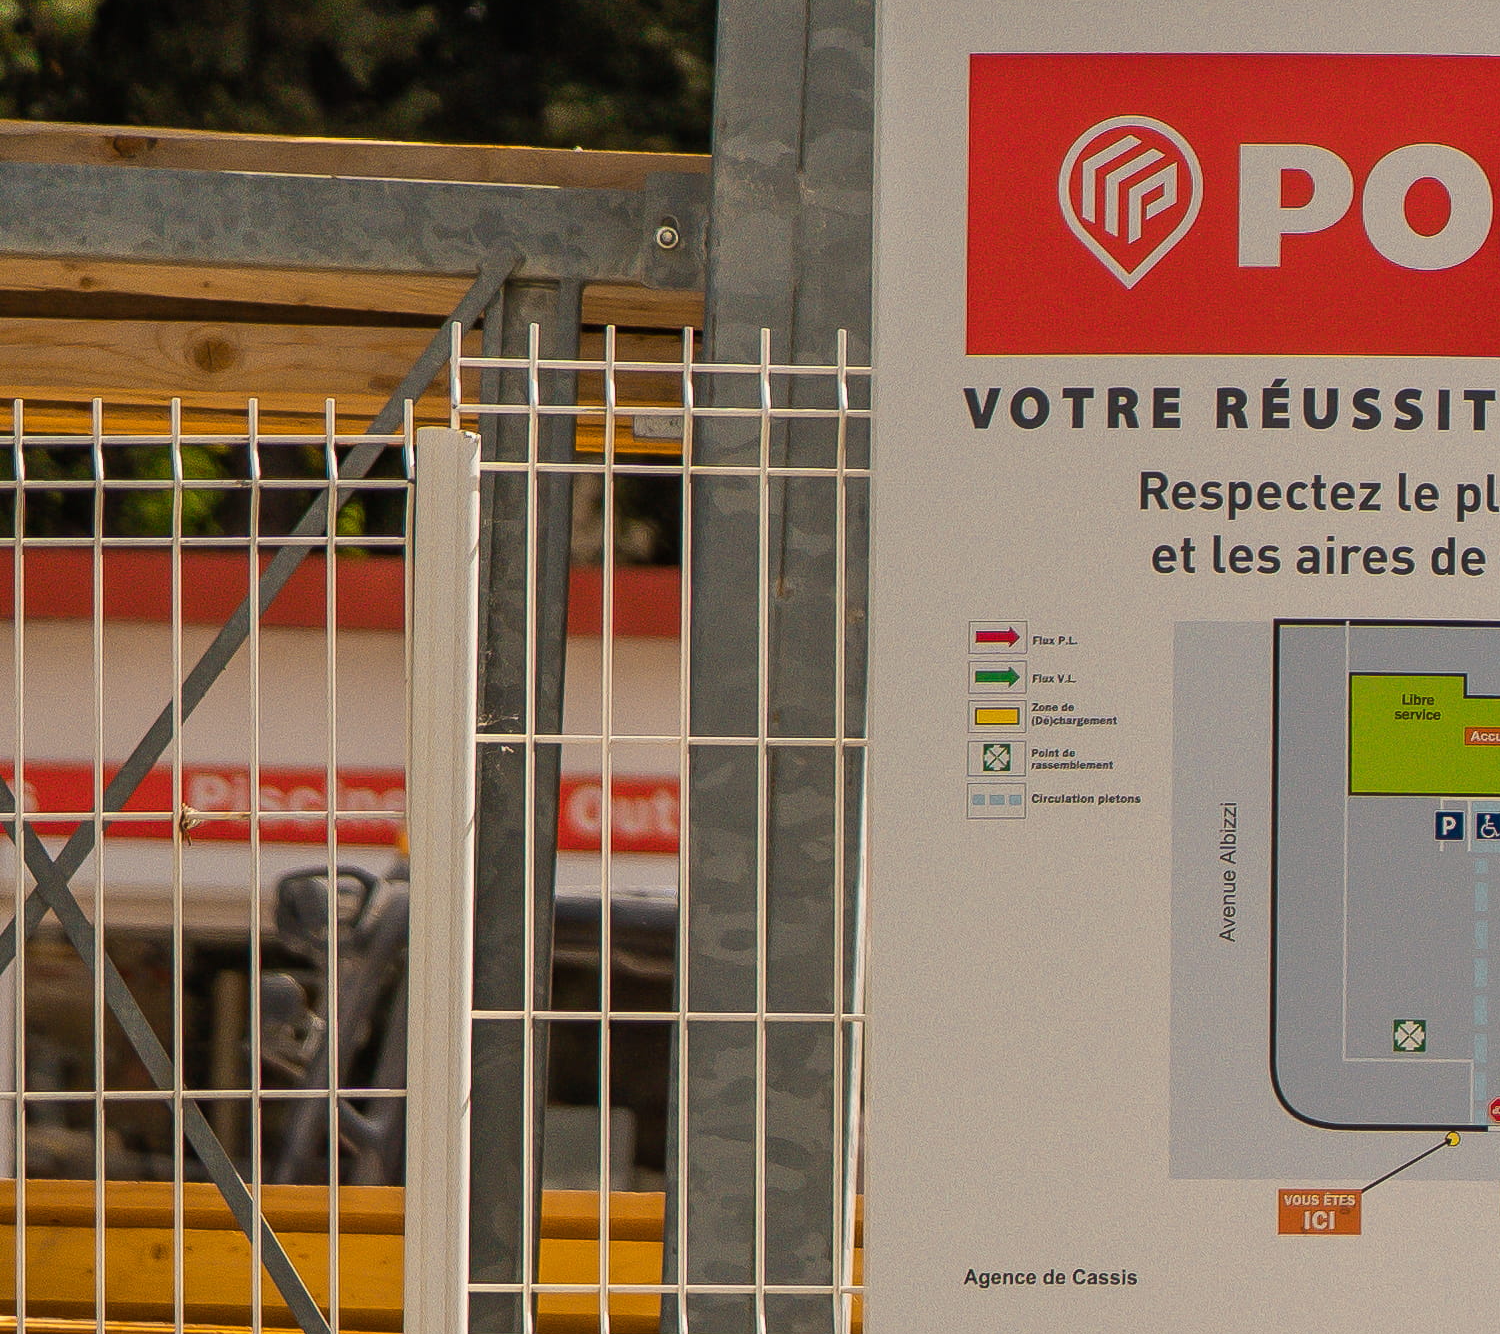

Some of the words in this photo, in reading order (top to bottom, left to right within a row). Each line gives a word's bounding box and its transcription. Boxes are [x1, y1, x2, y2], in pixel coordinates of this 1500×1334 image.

[964, 388, 1180, 429] VOTRE
[1141, 472, 1380, 520] Respectez
[1399, 473, 1439, 511] le
[1152, 538, 1195, 573] et
[1213, 535, 1280, 574] les
[1297, 536, 1414, 575] aires
[1432, 537, 1485, 576] de
[1033, 633, 1055, 646] Flux
[1058, 634, 1078, 646] P.L.
[1032, 672, 1055, 684] Flux
[1031, 701, 1059, 713] Zone
[1061, 701, 1075, 713] de
[1402, 694, 1435, 707] Libre
[1394, 709, 1442, 722] service
[1031, 748, 1060, 758] Point
[1062, 747, 1076, 758] de
[1031, 760, 1114, 771] rassemblement
[1031, 793, 1093, 805] Circulation
[1219, 803, 1237, 864] Albizzi
[1442, 817, 1457, 835] P
[1219, 870, 1236, 942] Avenue
[1284, 1194, 1319, 1206] VOUS
[1323, 1191, 1356, 1206] ÊTES
[1304, 1211, 1336, 1230] ICI
[964, 1269, 1038, 1288] Agence
[1043, 1269, 1064, 1285] de
[1073, 1269, 1137, 1285] Cassis
